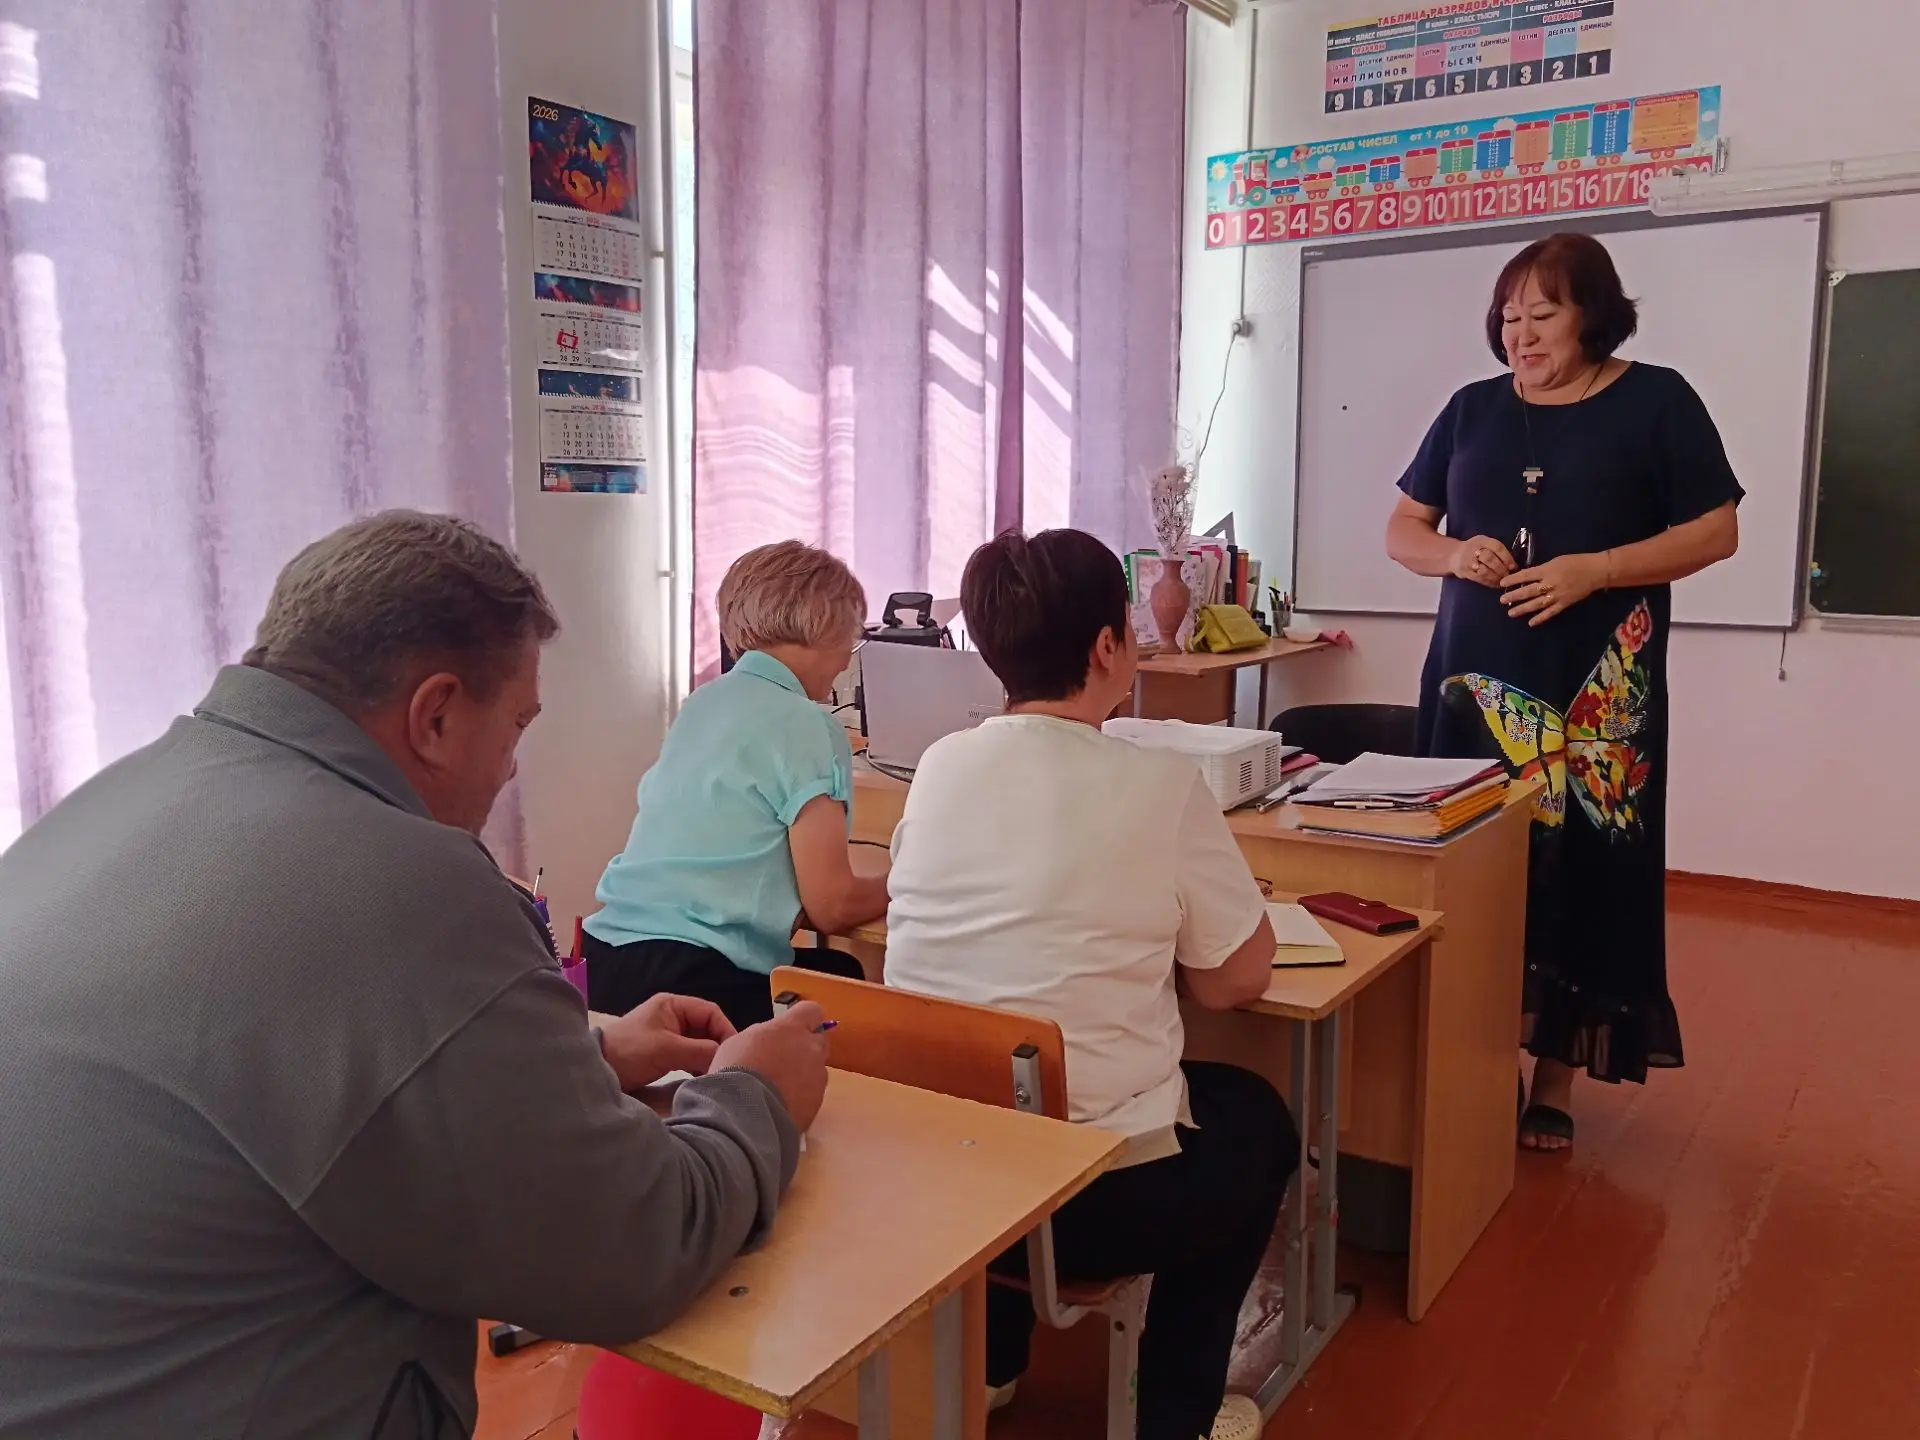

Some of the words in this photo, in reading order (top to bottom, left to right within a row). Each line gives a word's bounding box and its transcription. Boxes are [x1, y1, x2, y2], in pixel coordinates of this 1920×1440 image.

[1378, 10, 1427, 26] ТАБЛИЦА
[1430, 0, 1488, 18] РАЗРЯДОВ
[1543, 10, 1582, 24] РАЗРЯДЫ
[1443, 27, 1480, 39] РАЗРЯДЫ
[1352, 42, 1386, 55] РАЗРЯДЫ
[1358, 58, 1382, 67] ДЕСЯТКИ
[1386, 54, 1414, 62] ЕДИНИЦЫ
[1450, 43, 1476, 52] ДЕСЯТКИ
[1480, 38, 1510, 47] ЕДИНИЦЫ
[1548, 27, 1576, 37] ДЕСЯТКИ
[1581, 21, 1612, 31] ЕДИНИЦЫ
[1440, 56, 1482, 68] ТЫСЯЧ
[1333, 67, 1407, 85] МИЛЛИОНОВ
[1334, 93, 1344, 111] 9
[1363, 89, 1373, 107] 8
[1393, 84, 1403, 102] 7
[1425, 79, 1436, 97] 6
[1454, 75, 1465, 94] 5
[1487, 70, 1498, 88] 4
[1520, 65, 1531, 84] 3
[1552, 61, 1564, 80] 2
[1589, 56, 1598, 74] 1
[532, 105, 559, 120] 2026
[1310, 140, 1355, 155] СОСТАВ
[1358, 135, 1397, 148] ЧИСЕЛ
[1410, 133, 1423, 141] от
[1426, 130, 1431, 139] 1
[1435, 130, 1450, 139] до
[1455, 125, 1468, 135] 10
[1209, 218, 1224, 244] 0
[1232, 215, 1241, 239] 1
[1248, 212, 1265, 240] 2
[1270, 210, 1286, 237] 3
[1290, 208, 1308, 234] 4
[1313, 205, 1329, 232] 5
[1334, 202, 1352, 231] 6
[1356, 200, 1375, 228] 7
[1378, 197, 1397, 225] 8
[1402, 195, 1422, 223] 9
[1425, 192, 1447, 221] 10
[1450, 190, 1470, 218] 11
[1473, 187, 1497, 216] 12
[1499, 183, 1521, 213] 13
[1524, 181, 1546, 210] 14
[1550, 178, 1573, 208] 15
[1576, 174, 1600, 205] 16
[1603, 172, 1628, 203] 17
[1629, 168, 1654, 199] 18
